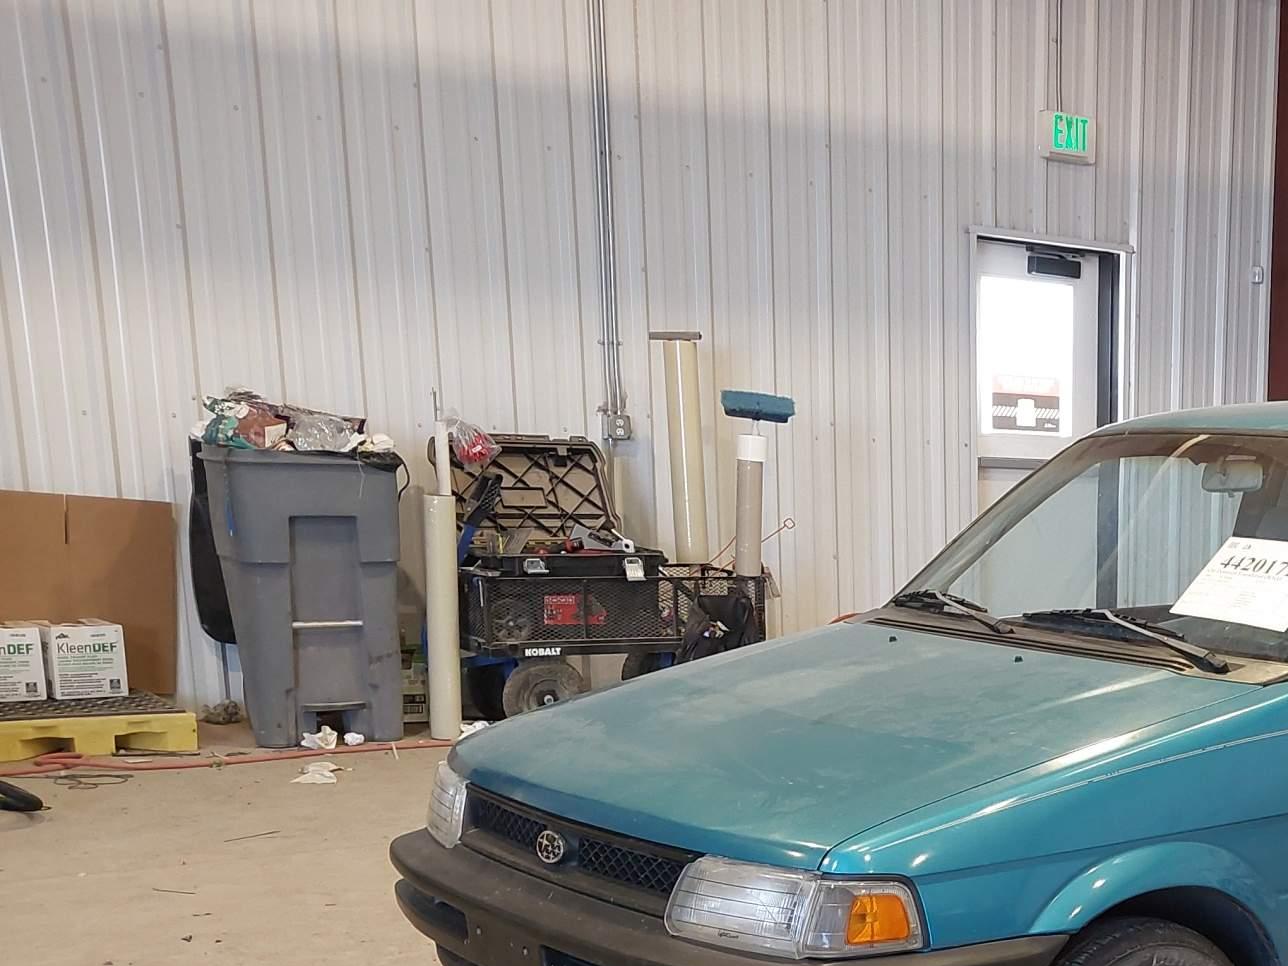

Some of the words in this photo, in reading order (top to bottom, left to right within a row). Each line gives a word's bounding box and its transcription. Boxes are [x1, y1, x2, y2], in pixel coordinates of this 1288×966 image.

[1053, 113, 1089, 152] EXIT
[57, 642, 118, 653] KleenDEF
[525, 648, 561, 656] KOBALT
